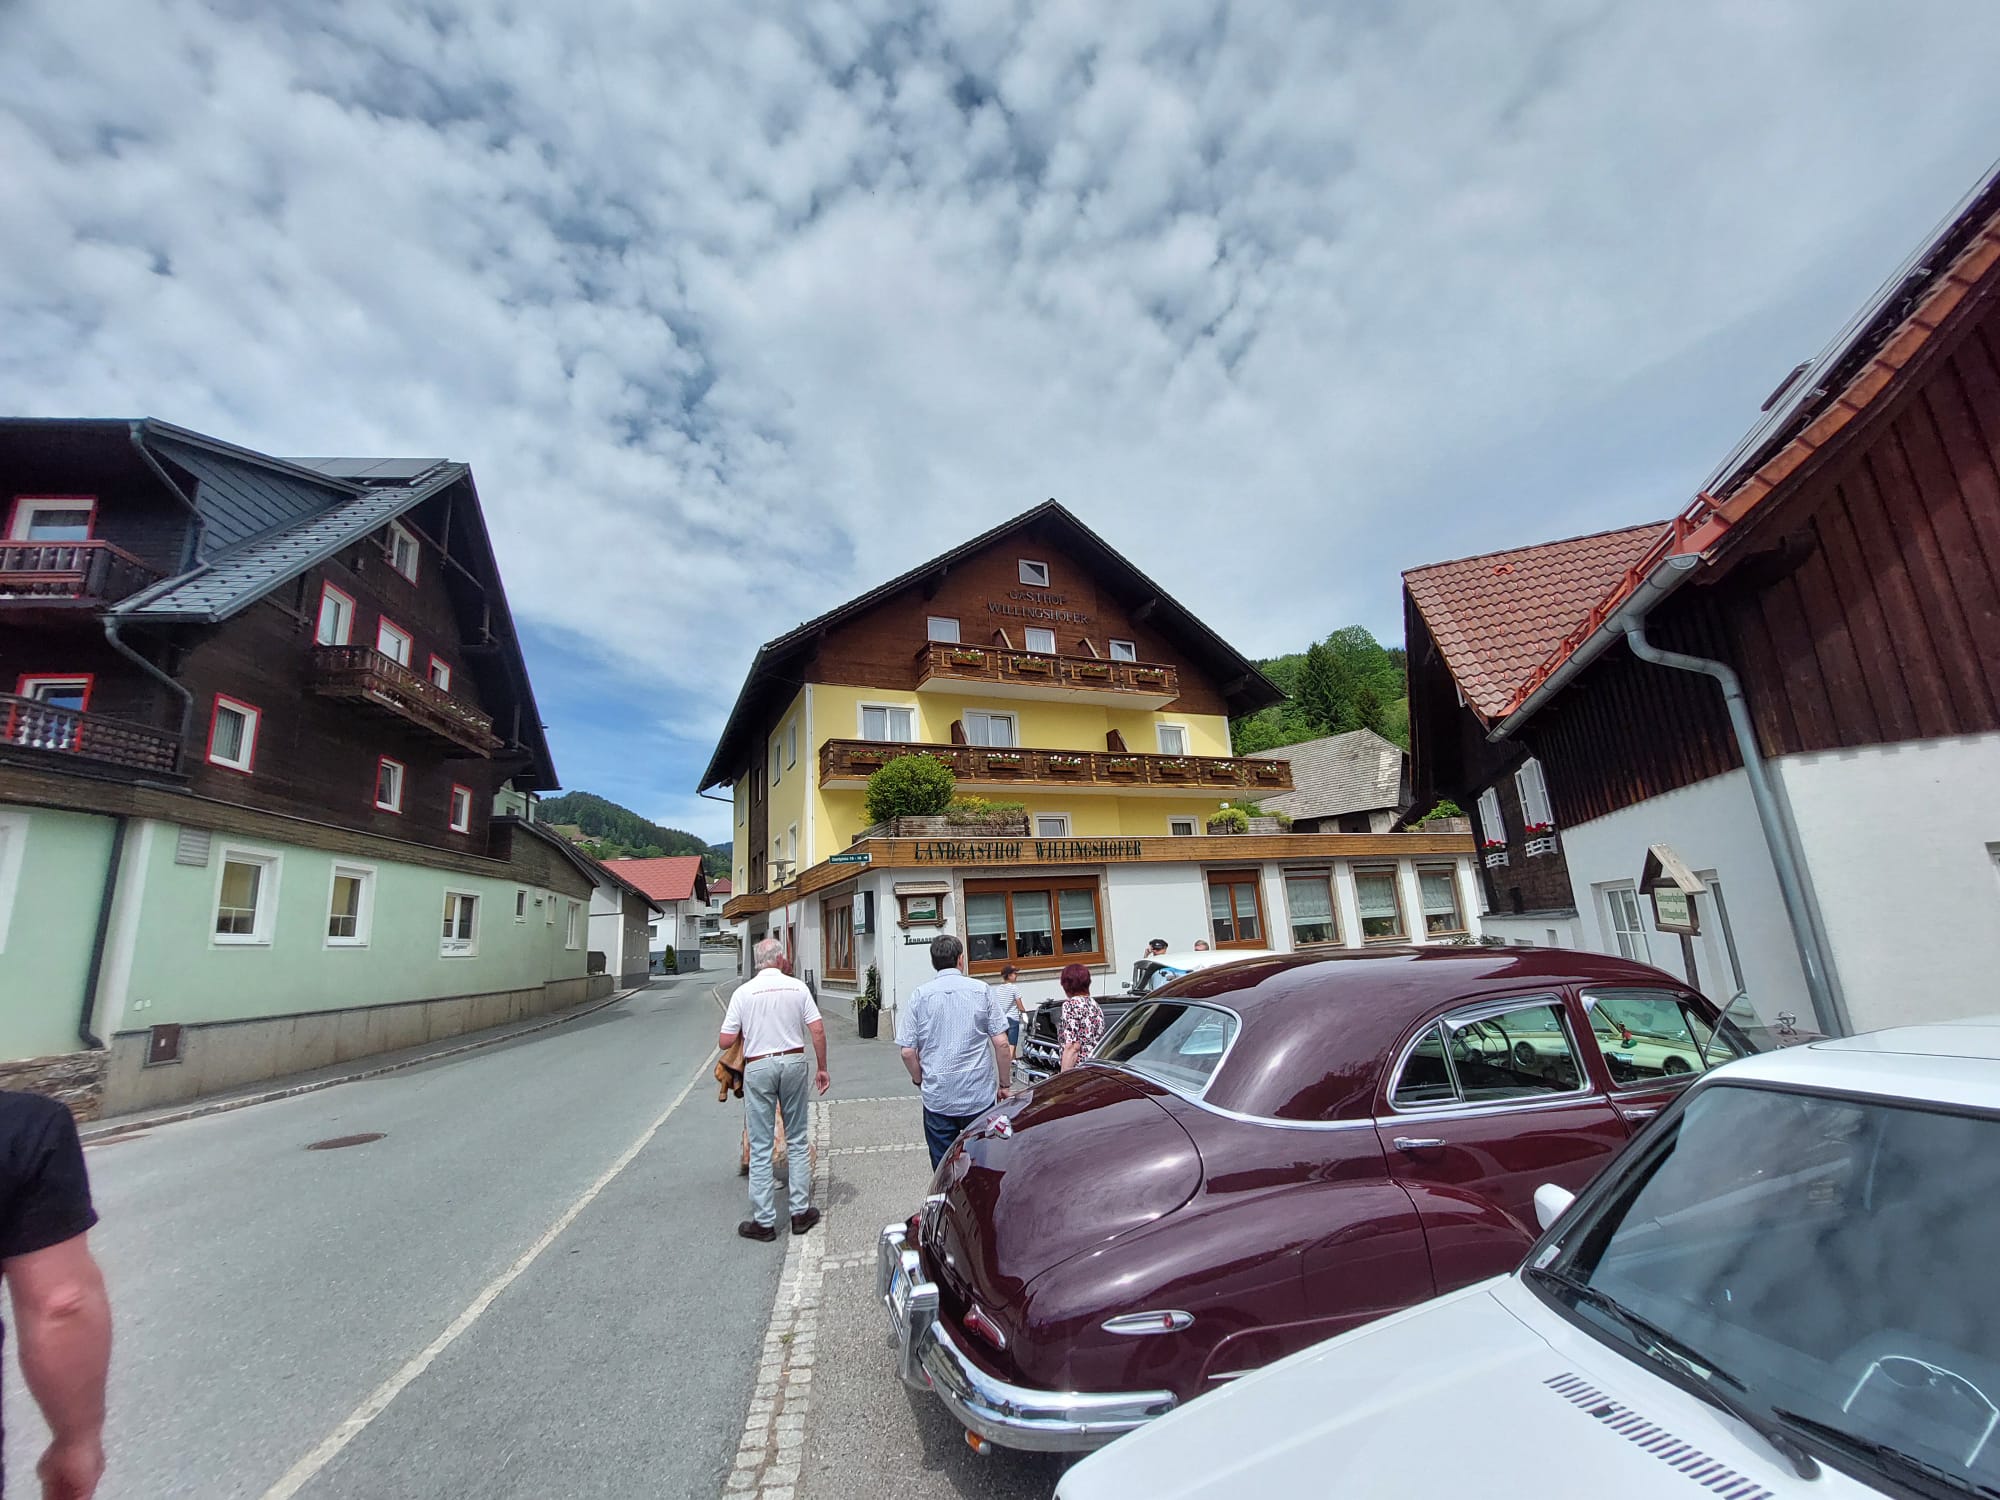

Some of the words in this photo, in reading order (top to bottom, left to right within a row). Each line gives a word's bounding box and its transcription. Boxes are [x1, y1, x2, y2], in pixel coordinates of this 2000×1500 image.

[1009, 591, 1065, 606] GASTHOF
[988, 601, 1089, 625] WILLINGSHOFER
[914, 841, 1024, 860] LANDGASTHOF
[1035, 840, 1142, 859] WILLINGSHOFER
